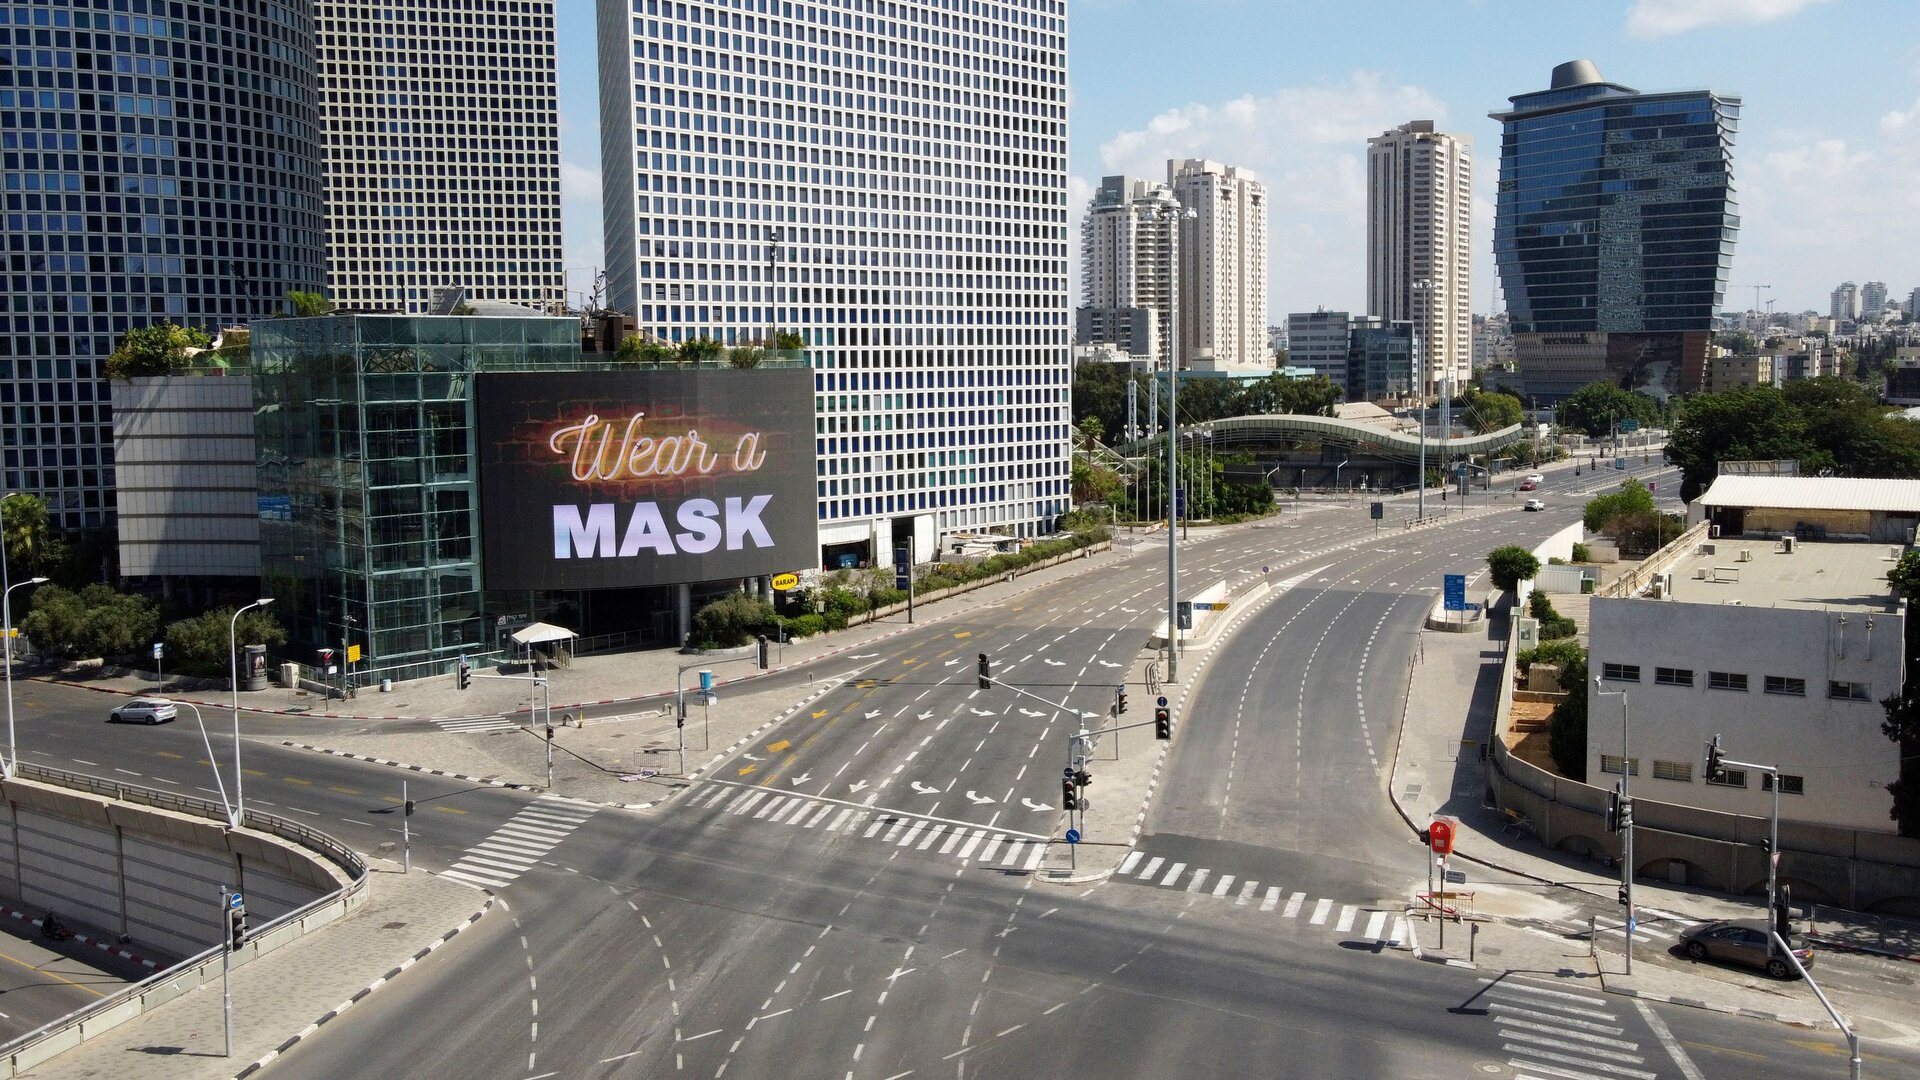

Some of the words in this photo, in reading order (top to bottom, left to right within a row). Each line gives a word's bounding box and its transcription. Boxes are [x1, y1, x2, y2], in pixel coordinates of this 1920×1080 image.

[550, 412, 718, 481] Wear
[735, 432, 767, 471] a
[553, 494, 776, 559] MASK
[775, 577, 795, 587] BARAM
